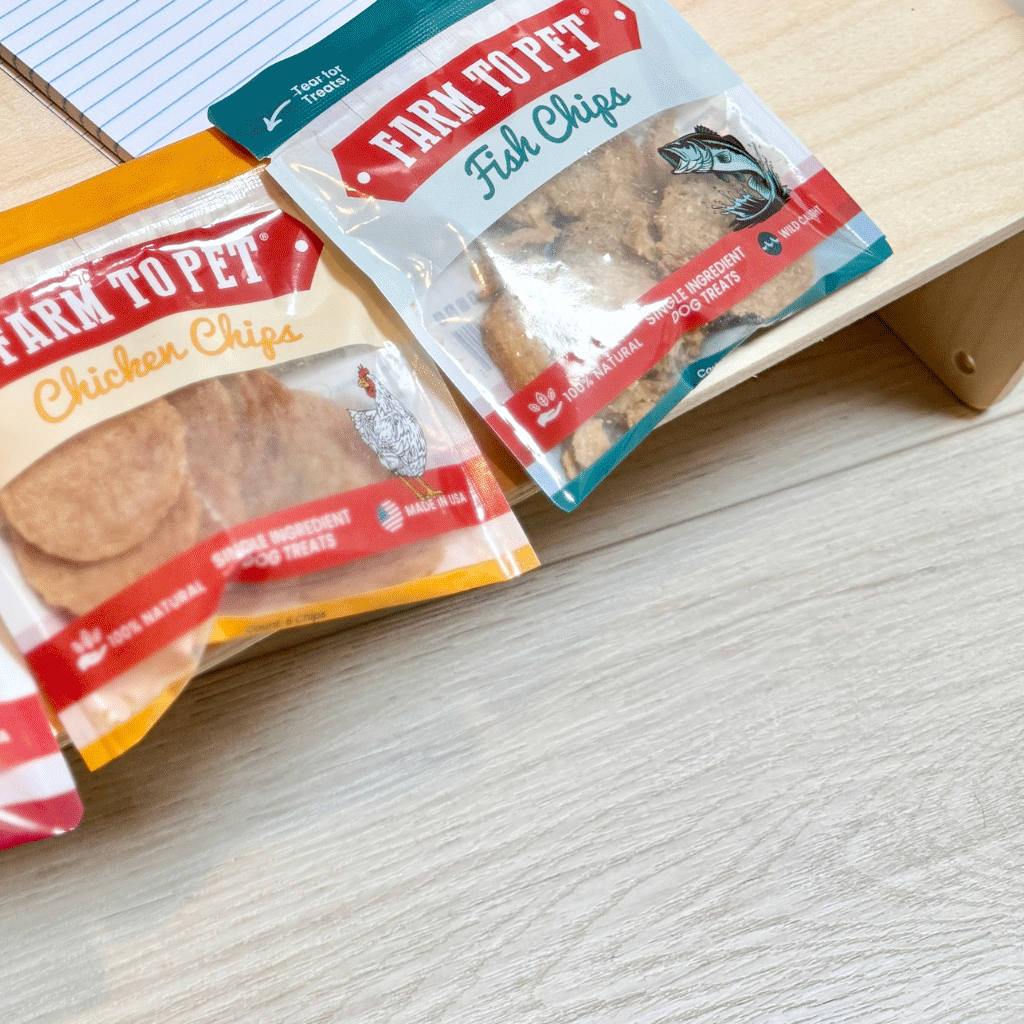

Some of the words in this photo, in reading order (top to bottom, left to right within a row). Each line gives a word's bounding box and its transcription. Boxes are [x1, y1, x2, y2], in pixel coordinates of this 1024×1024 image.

[290, 75, 323, 95] Tear
[321, 65, 342, 79] for
[301, 74, 350, 104] Treats!
[368, 81, 485, 168] FARM
[461, 50, 531, 97] TO
[464, 124, 541, 200] Fish
[532, 87, 632, 143] Chips
[777, 220, 801, 238] WILD
[106, 256, 177, 309] TO
[645, 287, 688, 325] SINGLE
[684, 245, 745, 295] INGREDIENT
[671, 298, 702, 324] DOG
[699, 270, 741, 304] TREATS
[33, 341, 189, 423] Chicken
[189, 313, 304, 360] Chips
[562, 376, 594, 402] 100%
[592, 338, 643, 380] NATURAL
[404, 497, 437, 517] MADE
[436, 495, 449, 508] IN
[447, 491, 468, 505] USA
[211, 533, 269, 568] SINGLE
[268, 508, 351, 545] INGREDIENT
[282, 532, 337, 561] TREATS
[140, 579, 208, 626] NATURAL
